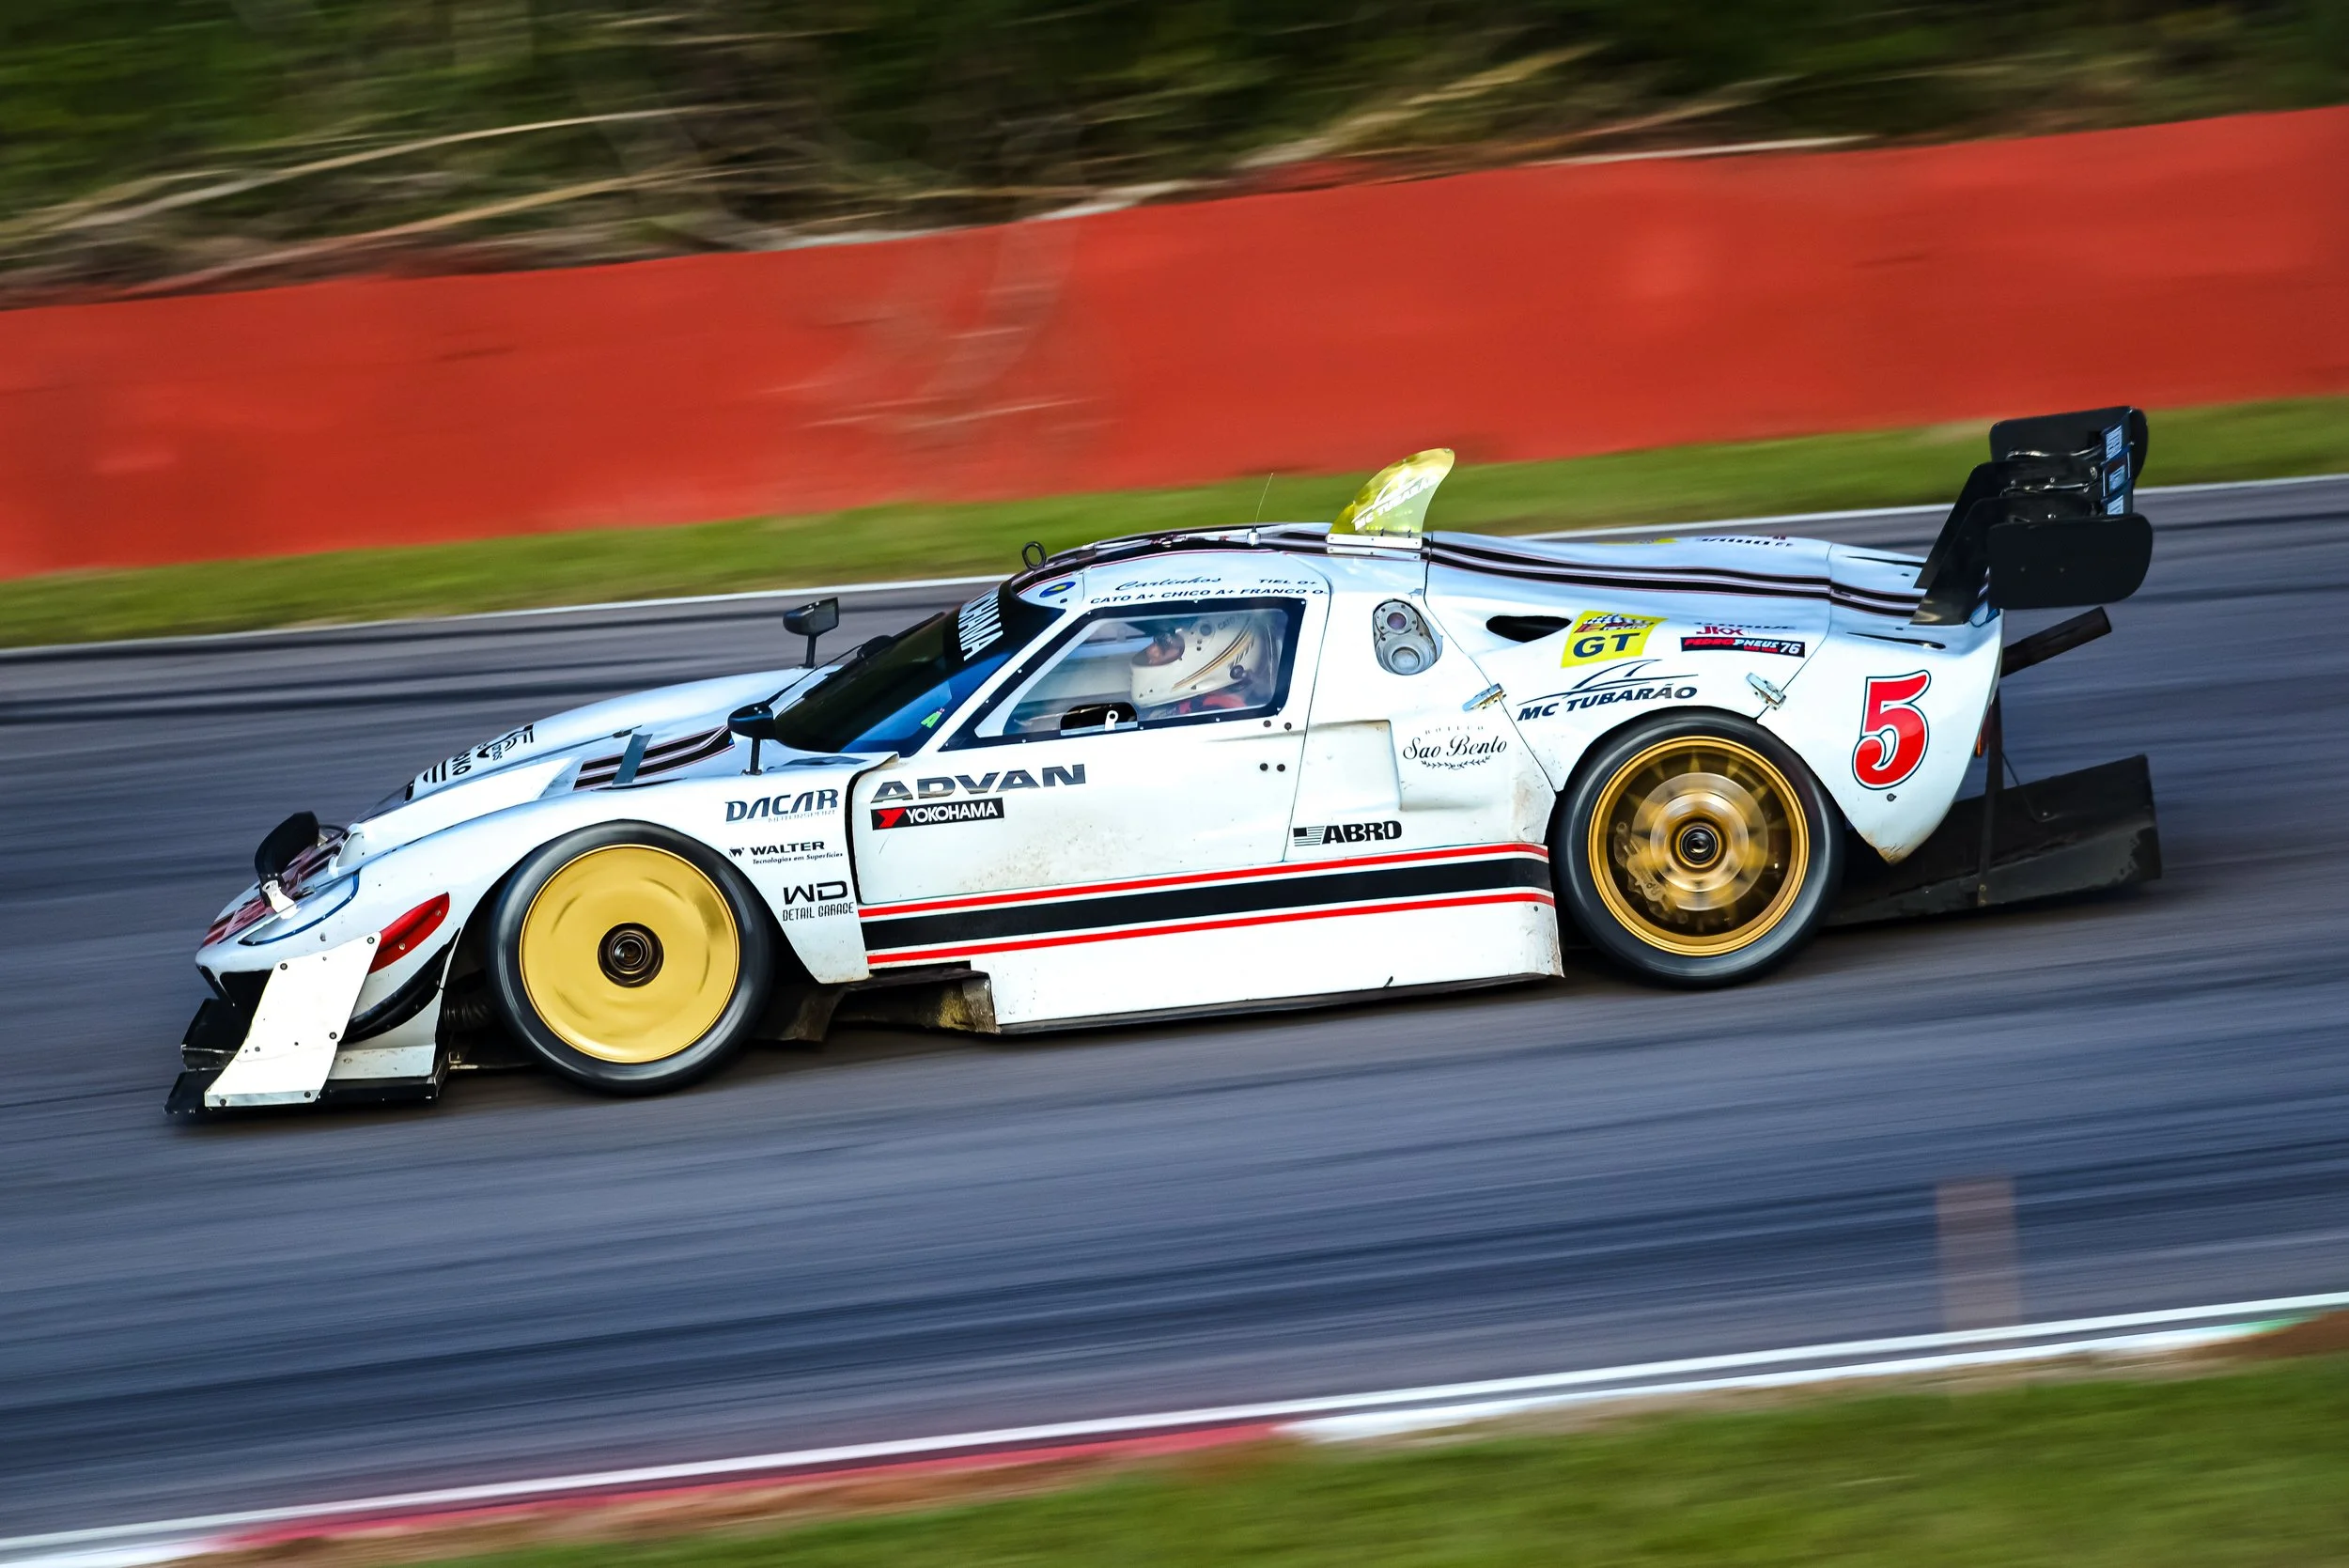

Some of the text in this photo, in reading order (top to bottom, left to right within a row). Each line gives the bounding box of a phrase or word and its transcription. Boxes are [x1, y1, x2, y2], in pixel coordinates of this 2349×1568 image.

[1090, 595, 1131, 605] CATO
[1161, 589, 1210, 598] CHICO
[1573, 632, 1641, 658] GT
[1780, 642, 1801, 655] 76
[1517, 683, 1698, 722] MC TUBARÃO
[1851, 669, 1932, 791] 5
[1446, 734, 1507, 756] Bento
[870, 764, 1086, 803] ADVAN
[724, 788, 839, 822] DACAR
[906, 801, 998, 824] YOKOHAMA
[1322, 820, 1403, 845] ABRO
[750, 841, 825, 856] WALTER
[783, 880, 848, 905] WD
[783, 902, 854, 922] DETAIL GARAGE
